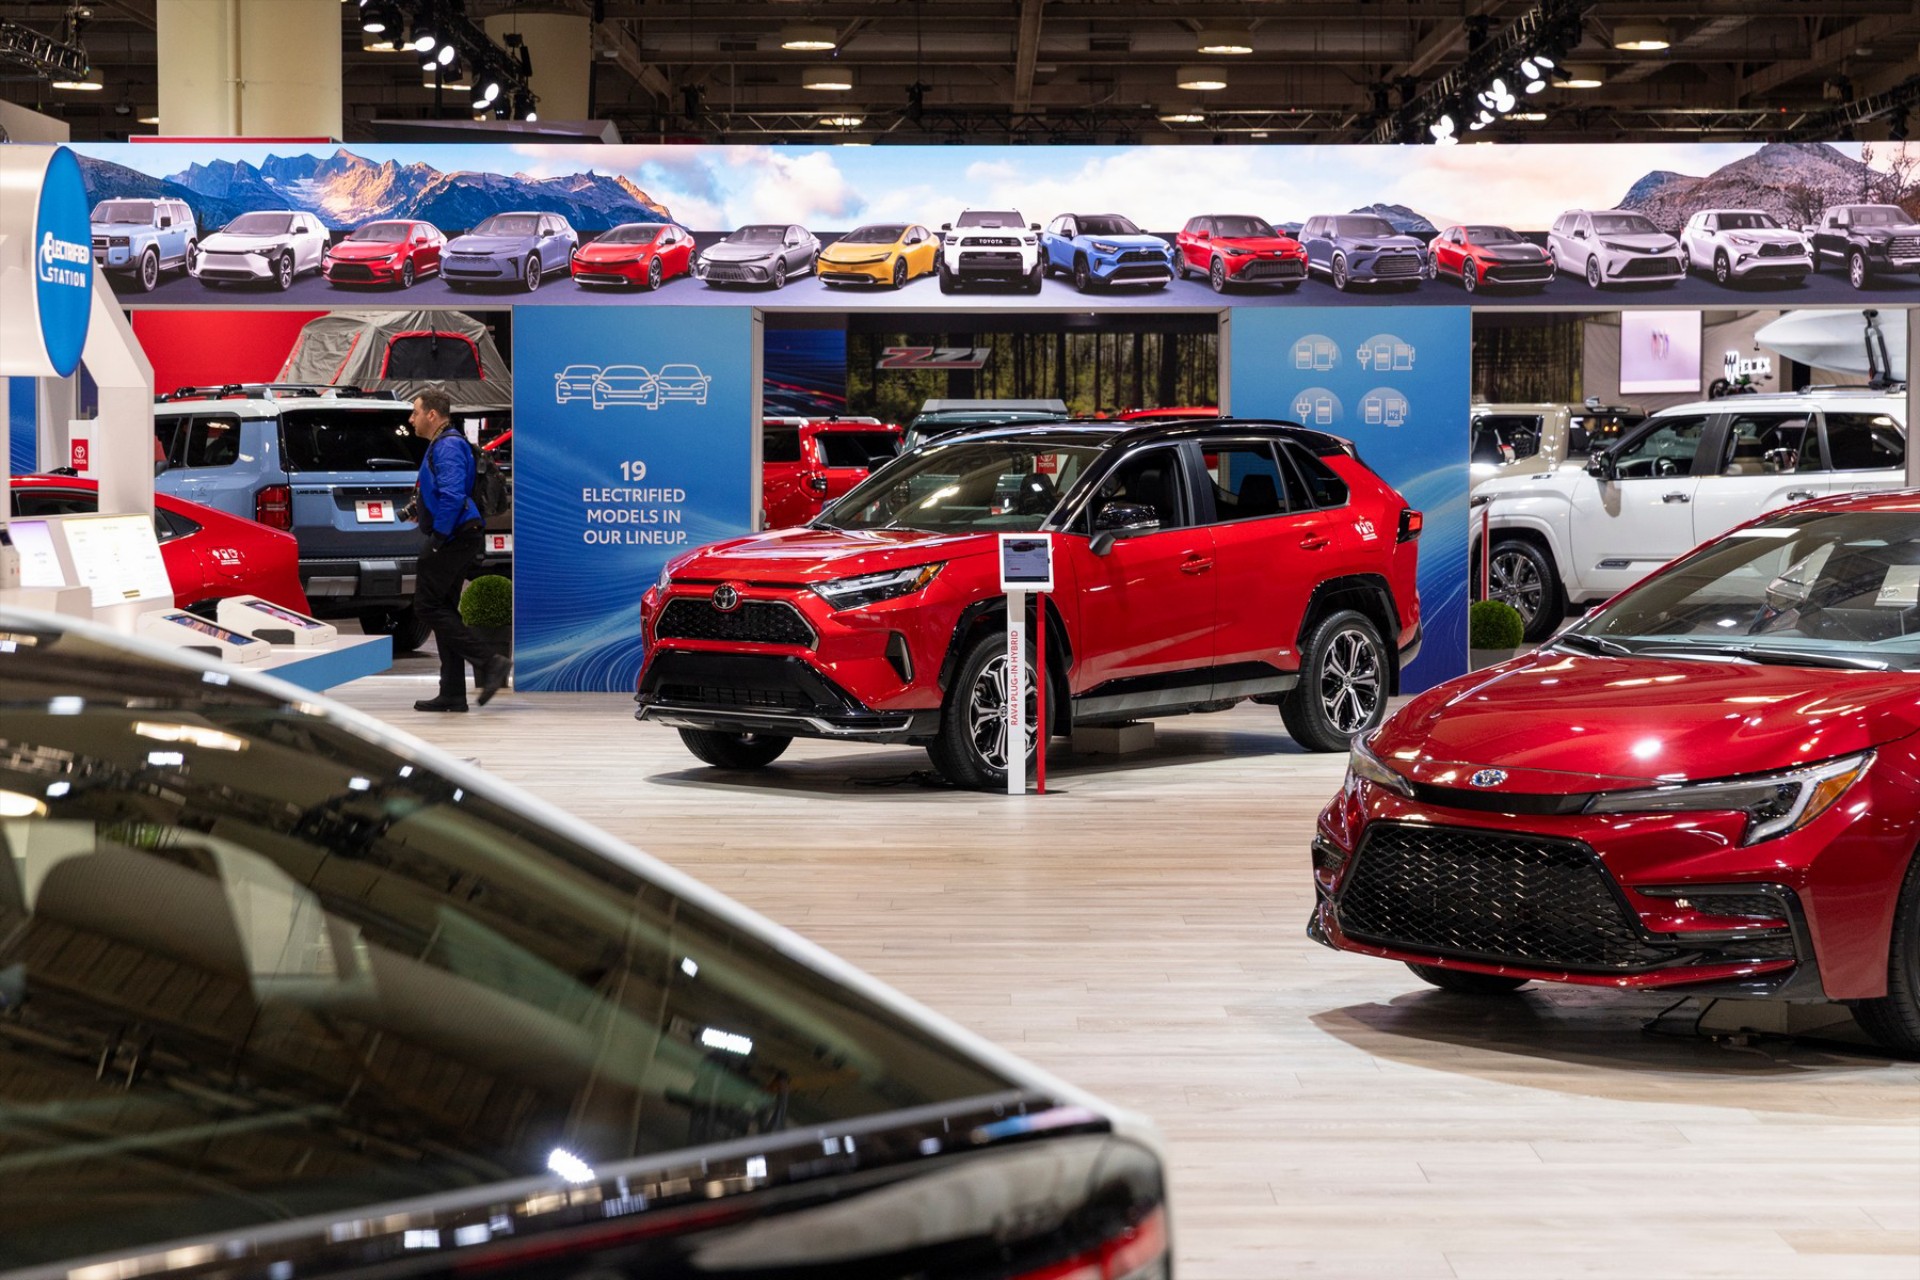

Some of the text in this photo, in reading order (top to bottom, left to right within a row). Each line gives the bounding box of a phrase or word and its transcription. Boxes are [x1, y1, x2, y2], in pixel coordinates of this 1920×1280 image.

[47, 266, 86, 288] STATION
[876, 347, 992, 369] Z71
[620, 460, 647, 481] 19
[582, 488, 686, 502] ELECTRIFIED
[587, 509, 681, 523] MODELS IN
[583, 530, 688, 544] OUR LINEUP.
[1010, 630, 1019, 726] RAV4 PLUG-IN HYBRID
